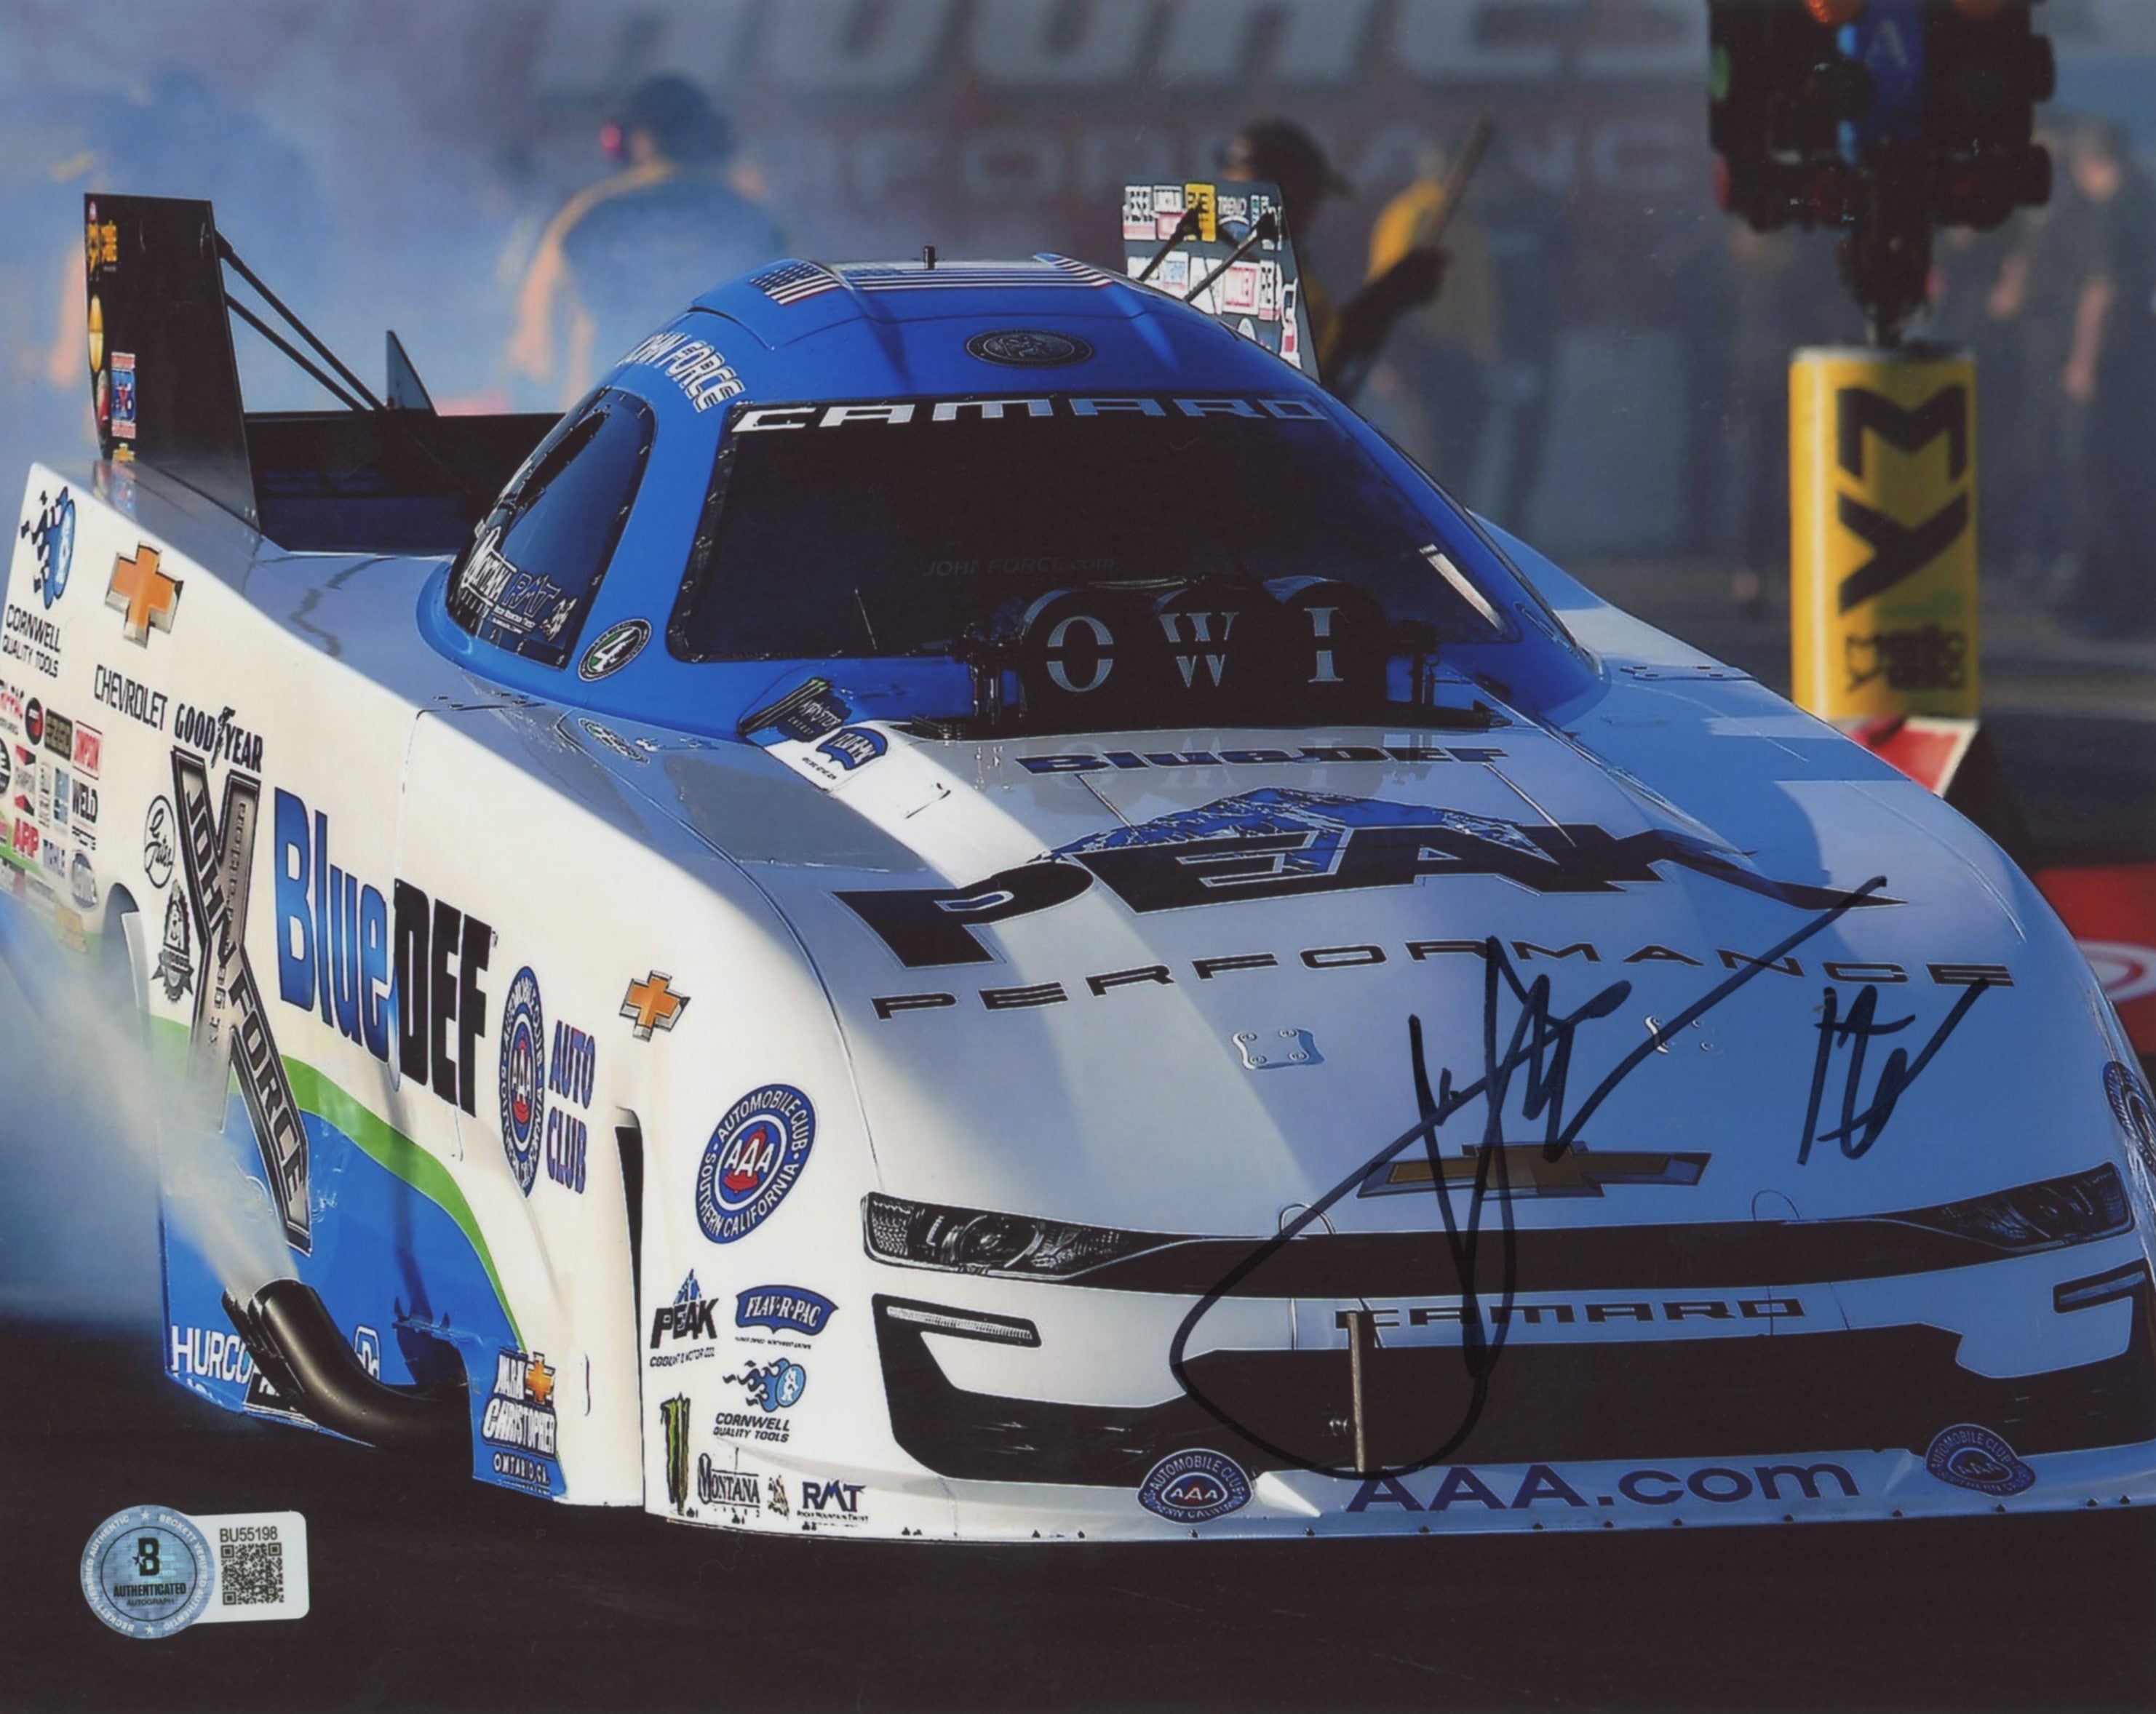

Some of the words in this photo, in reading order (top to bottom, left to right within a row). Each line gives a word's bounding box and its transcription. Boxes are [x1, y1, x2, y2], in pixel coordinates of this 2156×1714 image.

[654, 340, 746, 413] FORCE
[731, 398, 1328, 433] CAMARO
[6, 604, 60, 653] CORNWELL
[95, 663, 168, 731] CHEVROLET
[174, 703, 263, 773] GOODYEAR
[833, 824, 1908, 969] PEAK
[187, 788, 237, 968] JOHN
[228, 968, 305, 1203] FORCE
[872, 938, 2015, 1020] PERFORMANCE
[549, 1020, 596, 1109] AUTO
[717, 1090, 802, 1143] AUTOMOBILE
[789, 1109, 809, 1152] CLUB
[546, 1106, 588, 1195] CLUB
[724, 1138, 775, 1178] AAA
[699, 1152, 725, 1237] SOUTHERN
[723, 1163, 800, 1238] CALIFORNIA
[650, 1298, 719, 1350] PEAK
[1336, 1297, 1805, 1331] CAMARO
[713, 1427, 751, 1438] QUALITY
[755, 1429, 789, 1443] TOOLS
[715, 1412, 790, 1432] CORNWELL
[1930, 1430, 1984, 1469] AUTOMOBILE
[1150, 1455, 1222, 1491] AUTOMOBILE
[1170, 1487, 1218, 1500] AAA
[1345, 1462, 1861, 1512] AAA.com
[802, 1480, 867, 1512] RMT
[91, 1514, 130, 1558] AUTHENTIC
[159, 1513, 196, 1542] BECKETT
[220, 1526, 278, 1543] BU55198
[87, 1558, 99, 1603] VERIFIED
[194, 1541, 208, 1589] VERIFIED
[114, 1582, 186, 1598] AUTHENTICATED
[127, 1598, 174, 1606] AUTOGRAPH
[163, 1588, 206, 1631] AUTHENTIC
[96, 1603, 134, 1632] BECKETT
